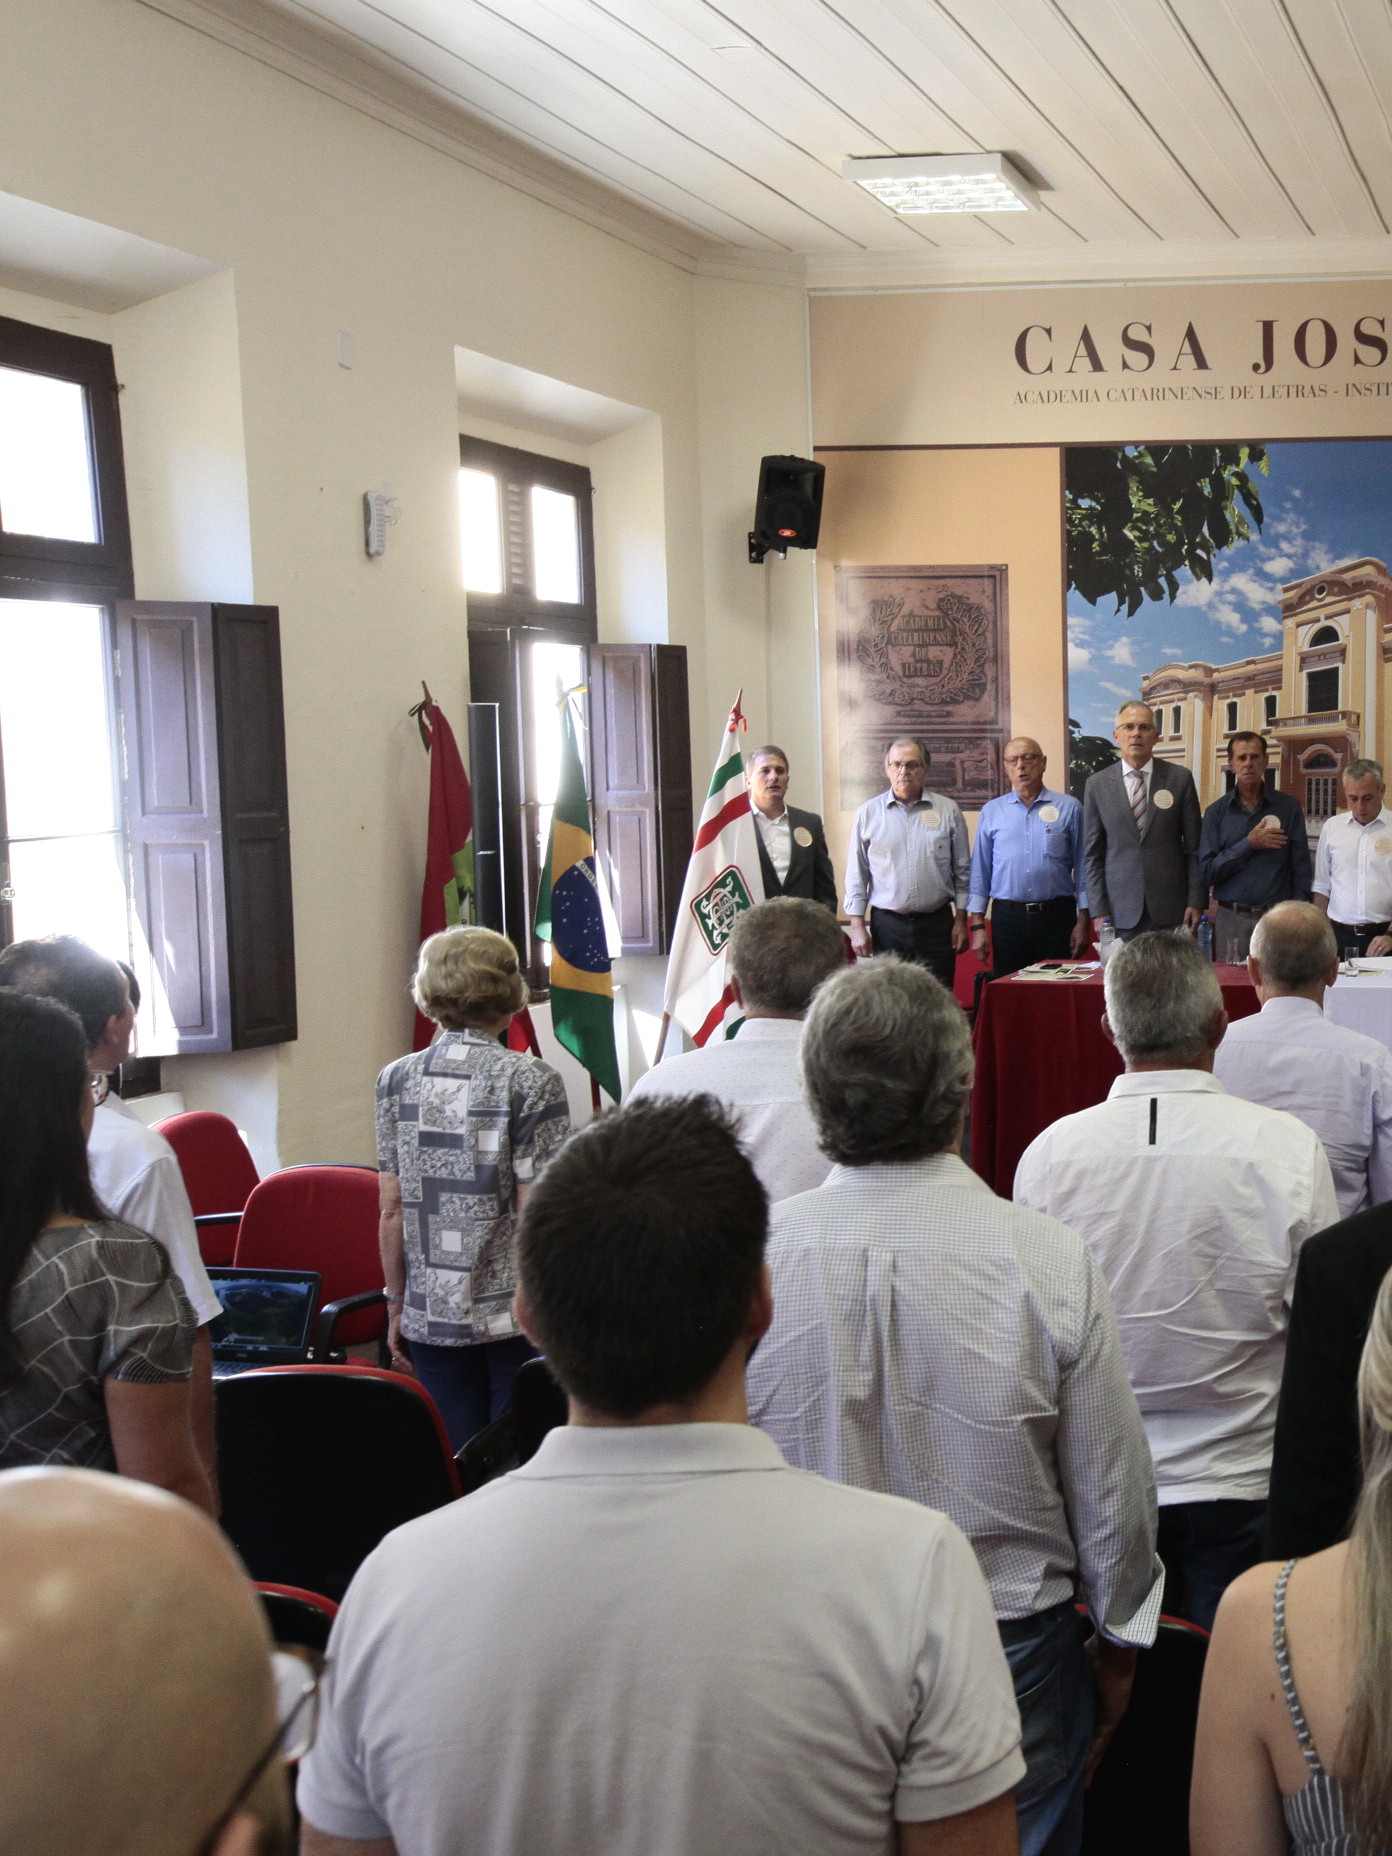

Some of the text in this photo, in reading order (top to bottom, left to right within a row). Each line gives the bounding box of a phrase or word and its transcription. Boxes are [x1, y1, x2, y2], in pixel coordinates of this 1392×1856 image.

[1014, 320, 1212, 376] CASA
[1013, 389, 1101, 405] ACADEMIA
[1106, 386, 1225, 402] CATARINENSE
[1230, 385, 1254, 400] DE
[1259, 383, 1328, 399] LETRAS
[898, 615, 945, 630] ACADEMIA
[904, 662, 941, 677] LETRAS
